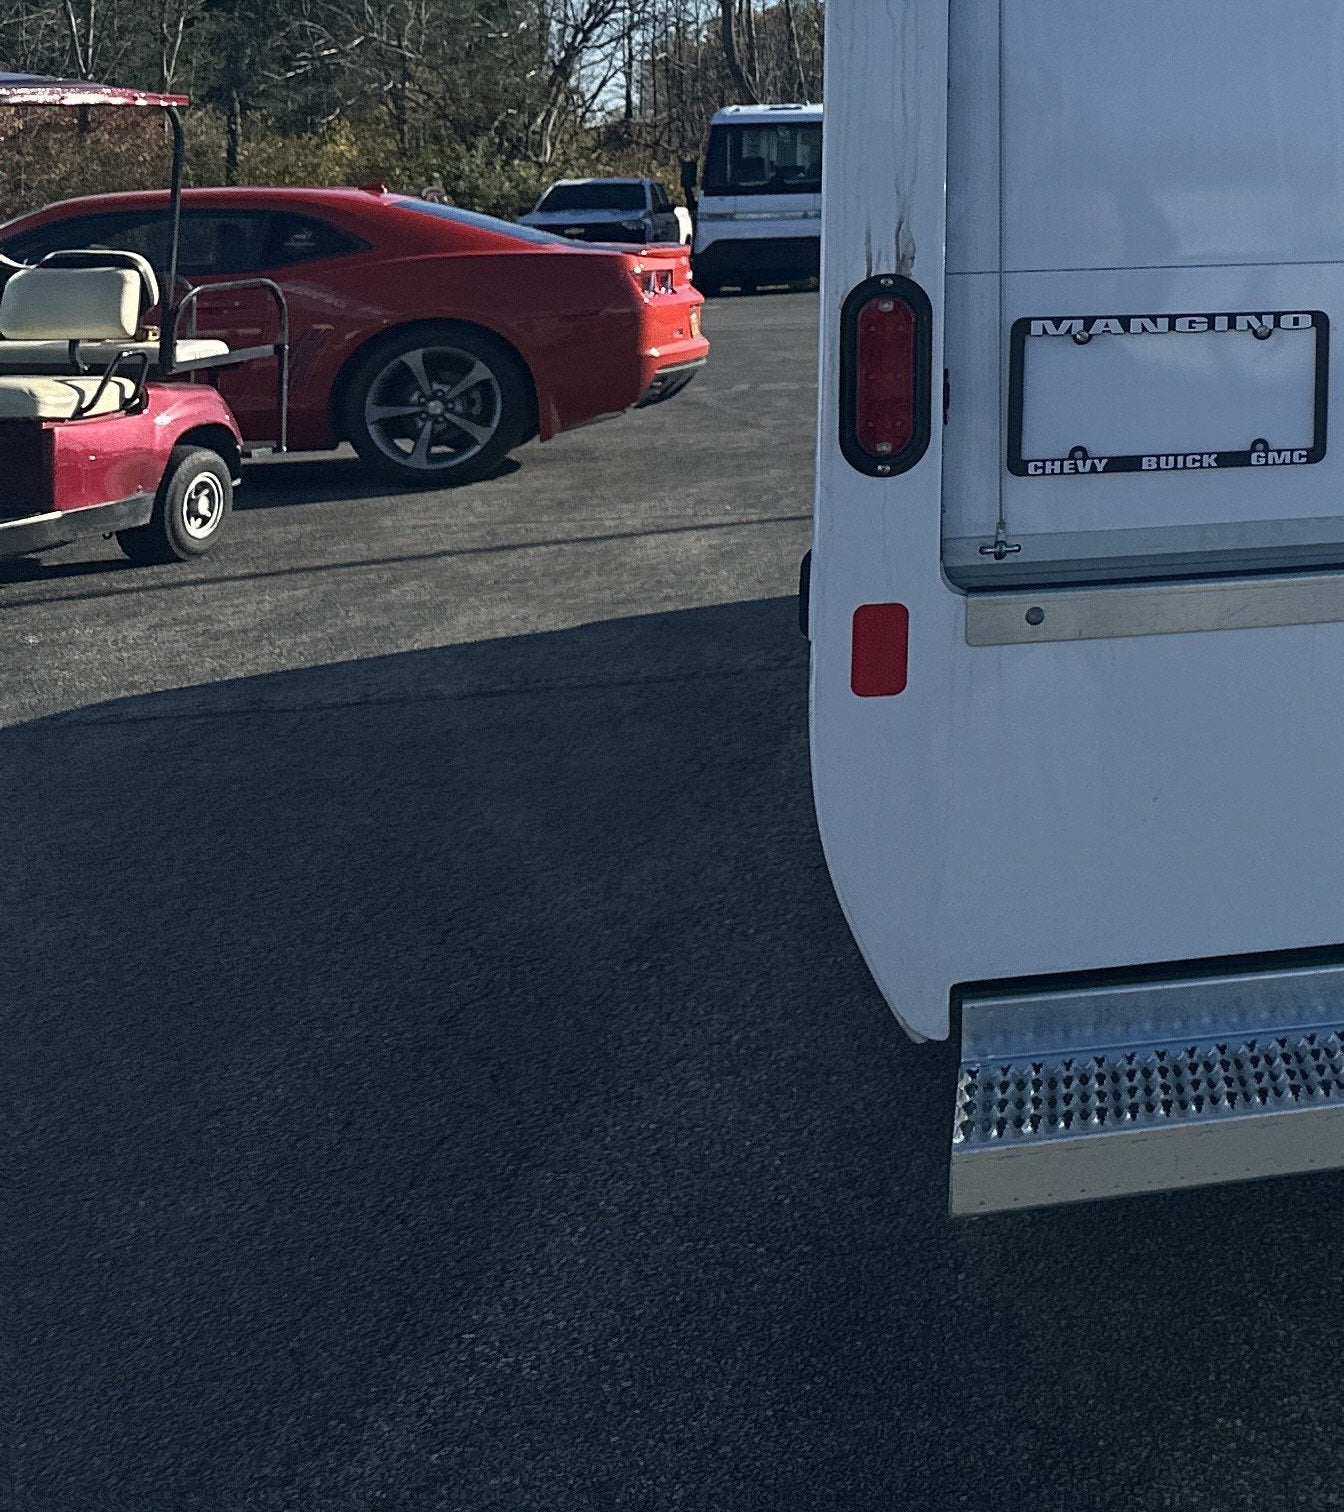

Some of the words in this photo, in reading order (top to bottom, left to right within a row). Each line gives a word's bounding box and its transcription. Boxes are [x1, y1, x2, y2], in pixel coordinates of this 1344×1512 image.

[1029, 314, 1313, 336] MANGINO
[1027, 459, 1109, 475] CHEVY
[1141, 453, 1219, 471] BUICK
[1250, 450, 1308, 466] GMC
